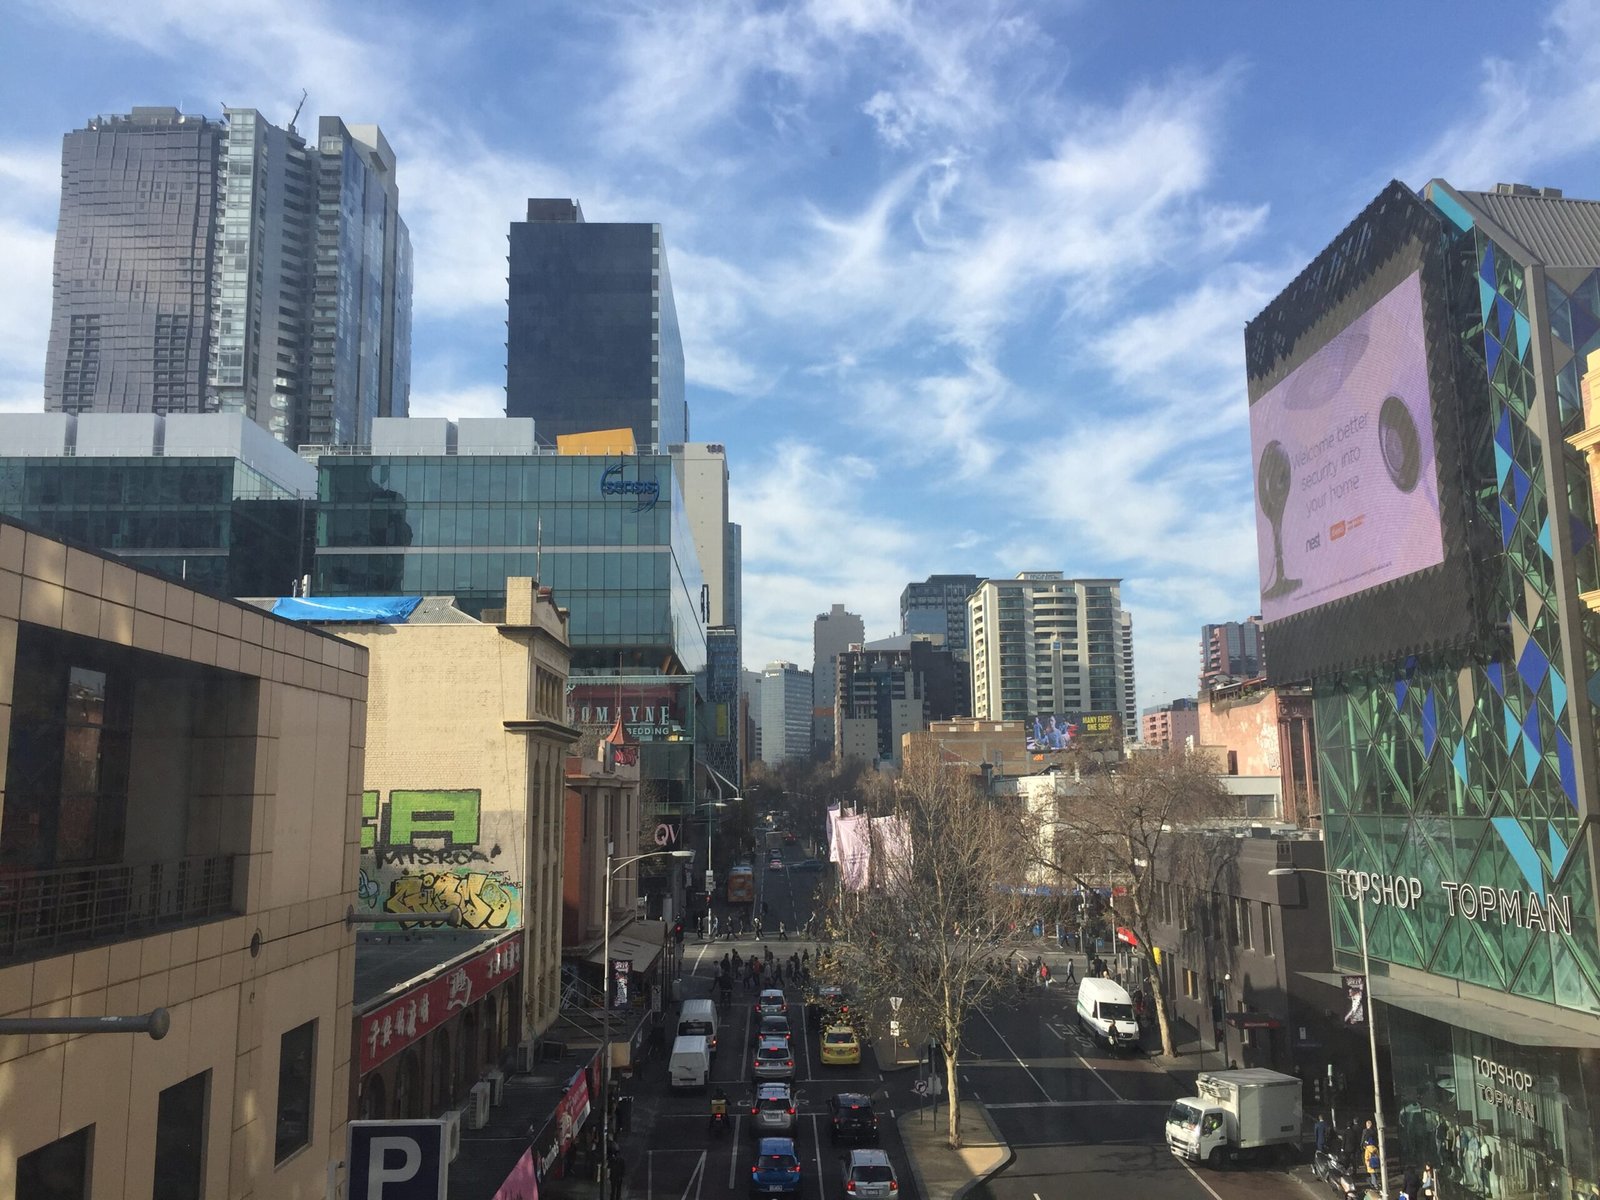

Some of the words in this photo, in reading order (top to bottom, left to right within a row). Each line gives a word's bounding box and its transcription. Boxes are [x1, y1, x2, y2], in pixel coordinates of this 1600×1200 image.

[1292, 433, 1335, 470] Welcome
[1337, 411, 1369, 442] better
[1301, 461, 1337, 491] security
[1341, 446, 1361, 468] into
[1305, 492, 1327, 519] your
[1329, 475, 1360, 498] home
[1305, 532, 1321, 552] nest
[626, 727, 669, 736] BEDDING
[1082, 716, 1097, 724] MANY
[1087, 723, 1098, 731] ONE
[655, 823, 682, 846] QV
[1336, 868, 1422, 910] TOPSHOP
[1440, 881, 1572, 936] TOPMAN
[1473, 1055, 1533, 1094] TOPSHOP
[1476, 1082, 1537, 1123] TOPMAN
[367, 1135, 422, 1200] P
